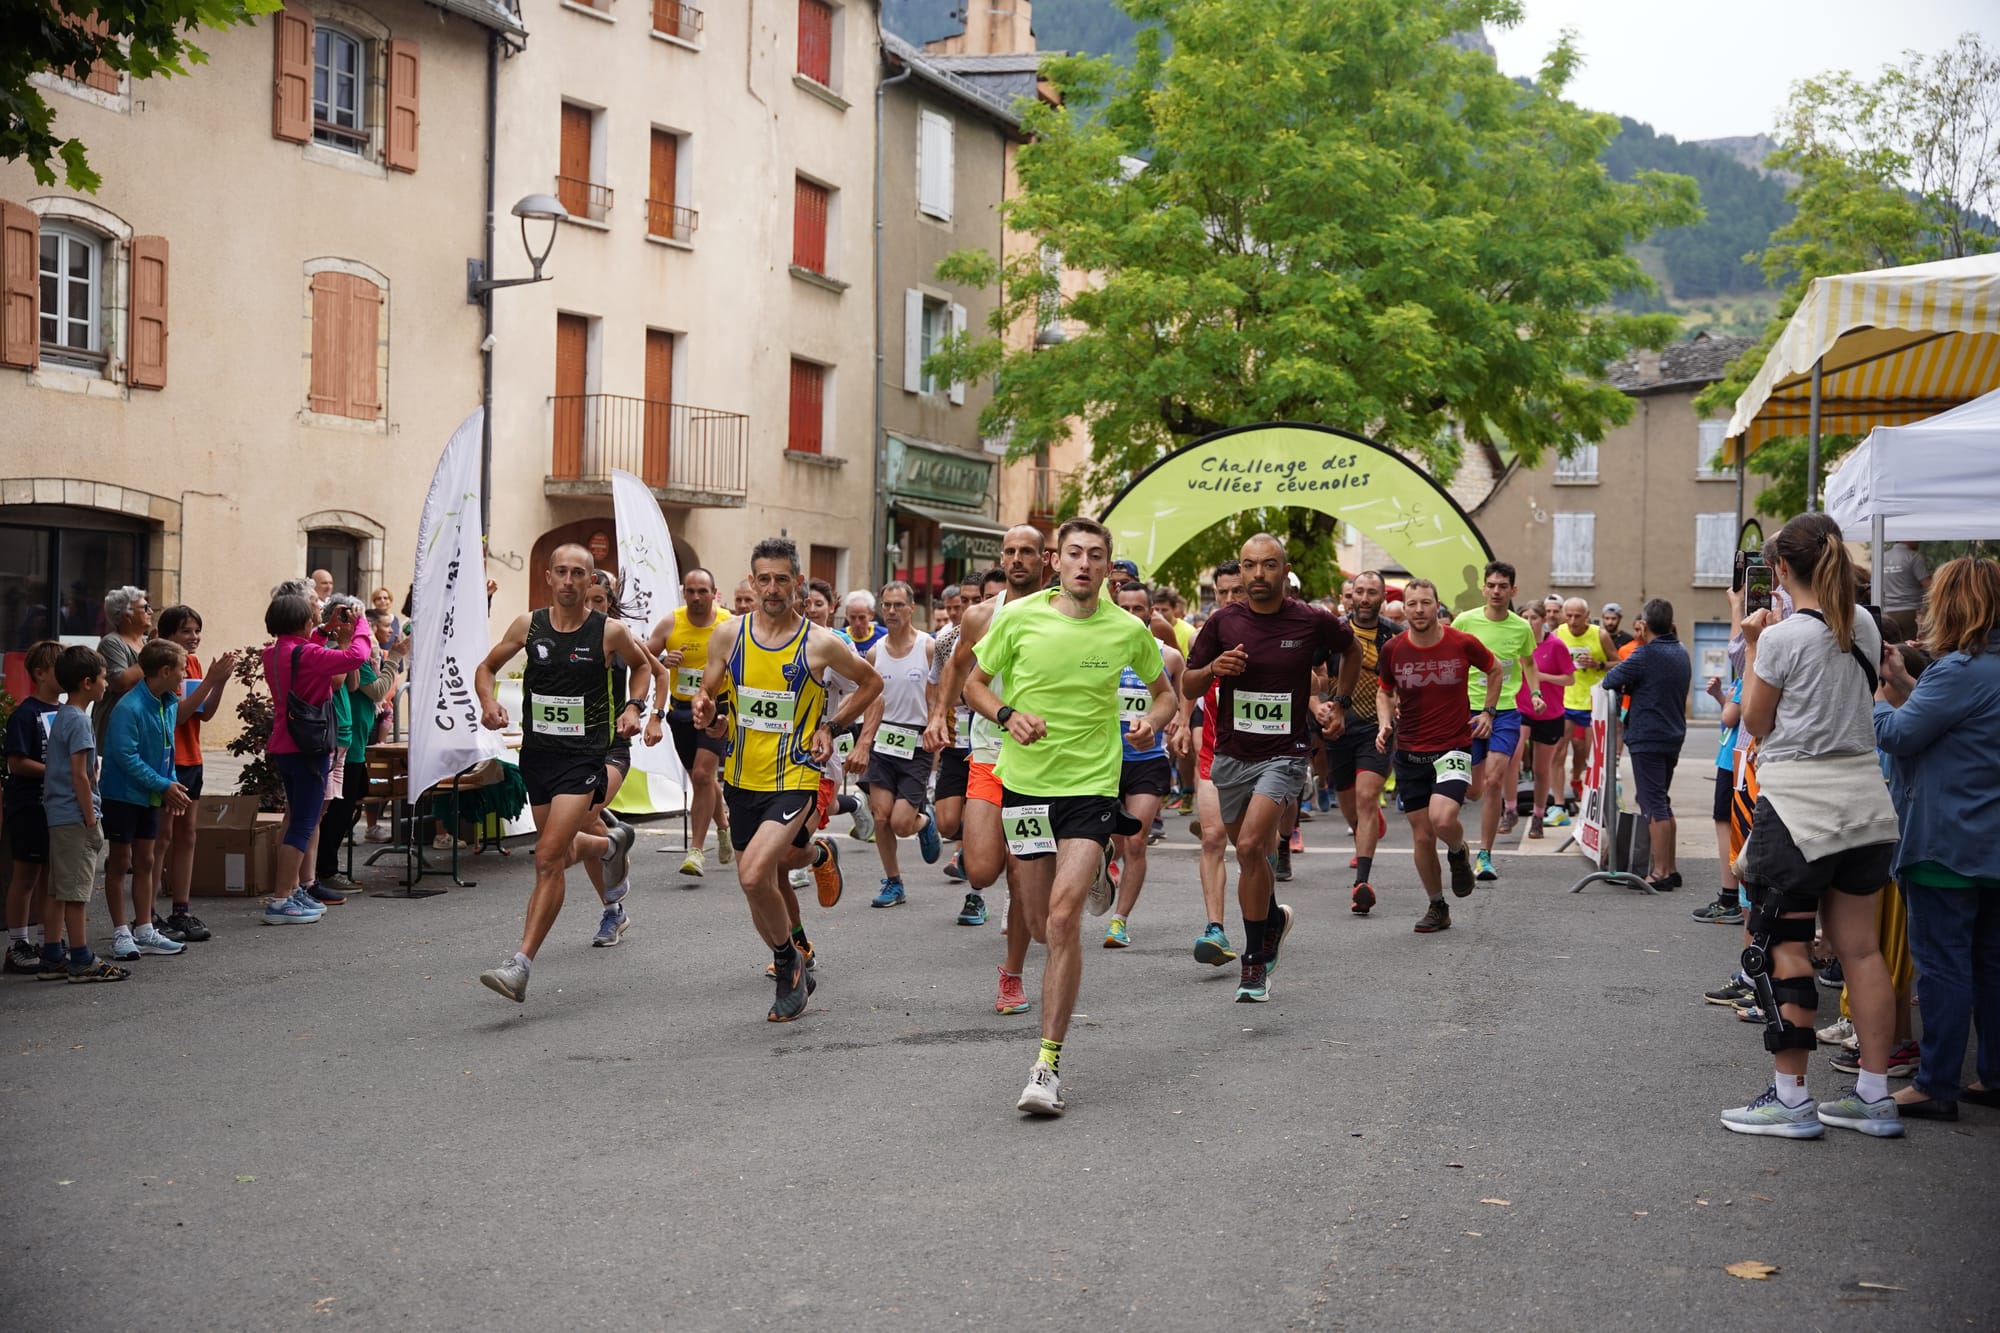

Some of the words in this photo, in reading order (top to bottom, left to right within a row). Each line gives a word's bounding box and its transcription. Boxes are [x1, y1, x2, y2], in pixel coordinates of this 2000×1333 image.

[1201, 457, 1307, 478] Challenge
[1322, 454, 1357, 470] des
[1188, 476, 1262, 493] vallées
[1277, 473, 1370, 493] cévenoles
[750, 700, 778, 718] 48
[1124, 697, 1146, 711] 70
[1241, 703, 1283, 720] 104
[543, 706, 569, 722] 55
[886, 733, 905, 747] 82
[1446, 759, 1465, 770] 35
[1015, 818, 1042, 838] 43
